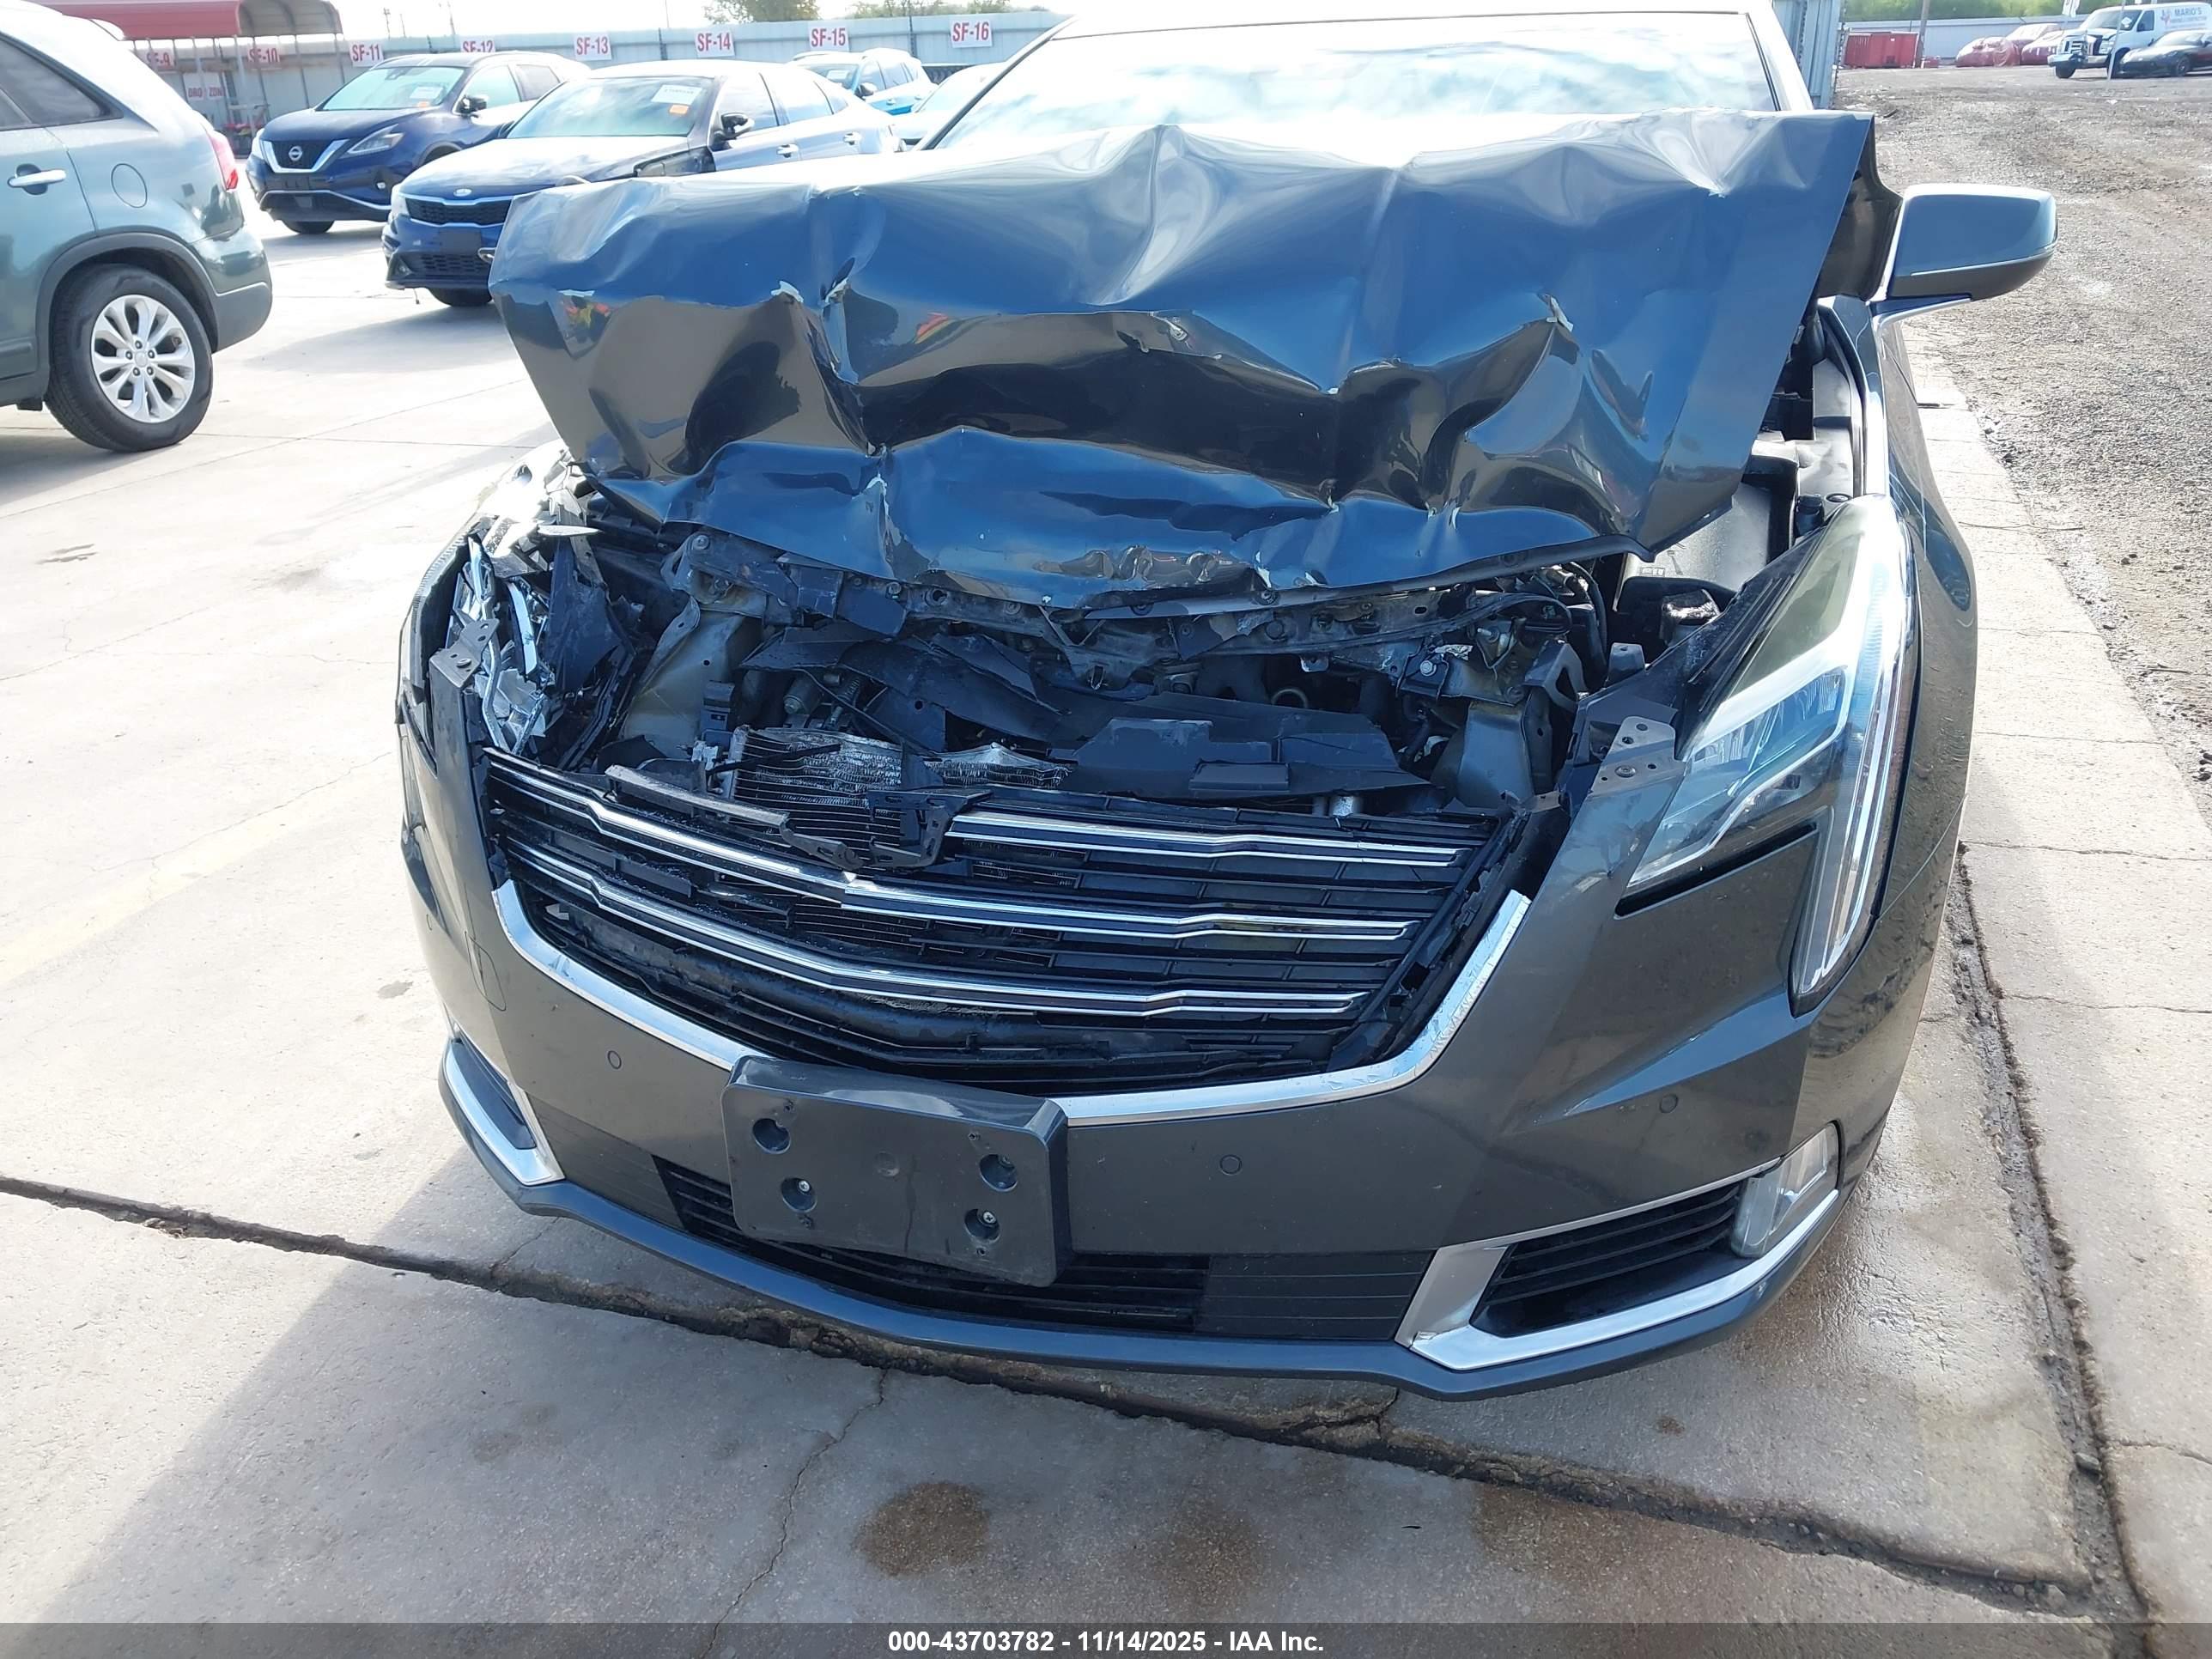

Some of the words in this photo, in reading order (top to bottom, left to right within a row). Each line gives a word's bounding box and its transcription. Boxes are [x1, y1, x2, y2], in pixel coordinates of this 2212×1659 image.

[811, 27, 846, 47] SF-15
[952, 21, 989, 42] SF-16
[576, 36, 608, 55] SF-13
[697, 32, 731, 52] SF-14
[249, 47, 278, 64] SF-10
[352, 44, 380, 63] SF-11
